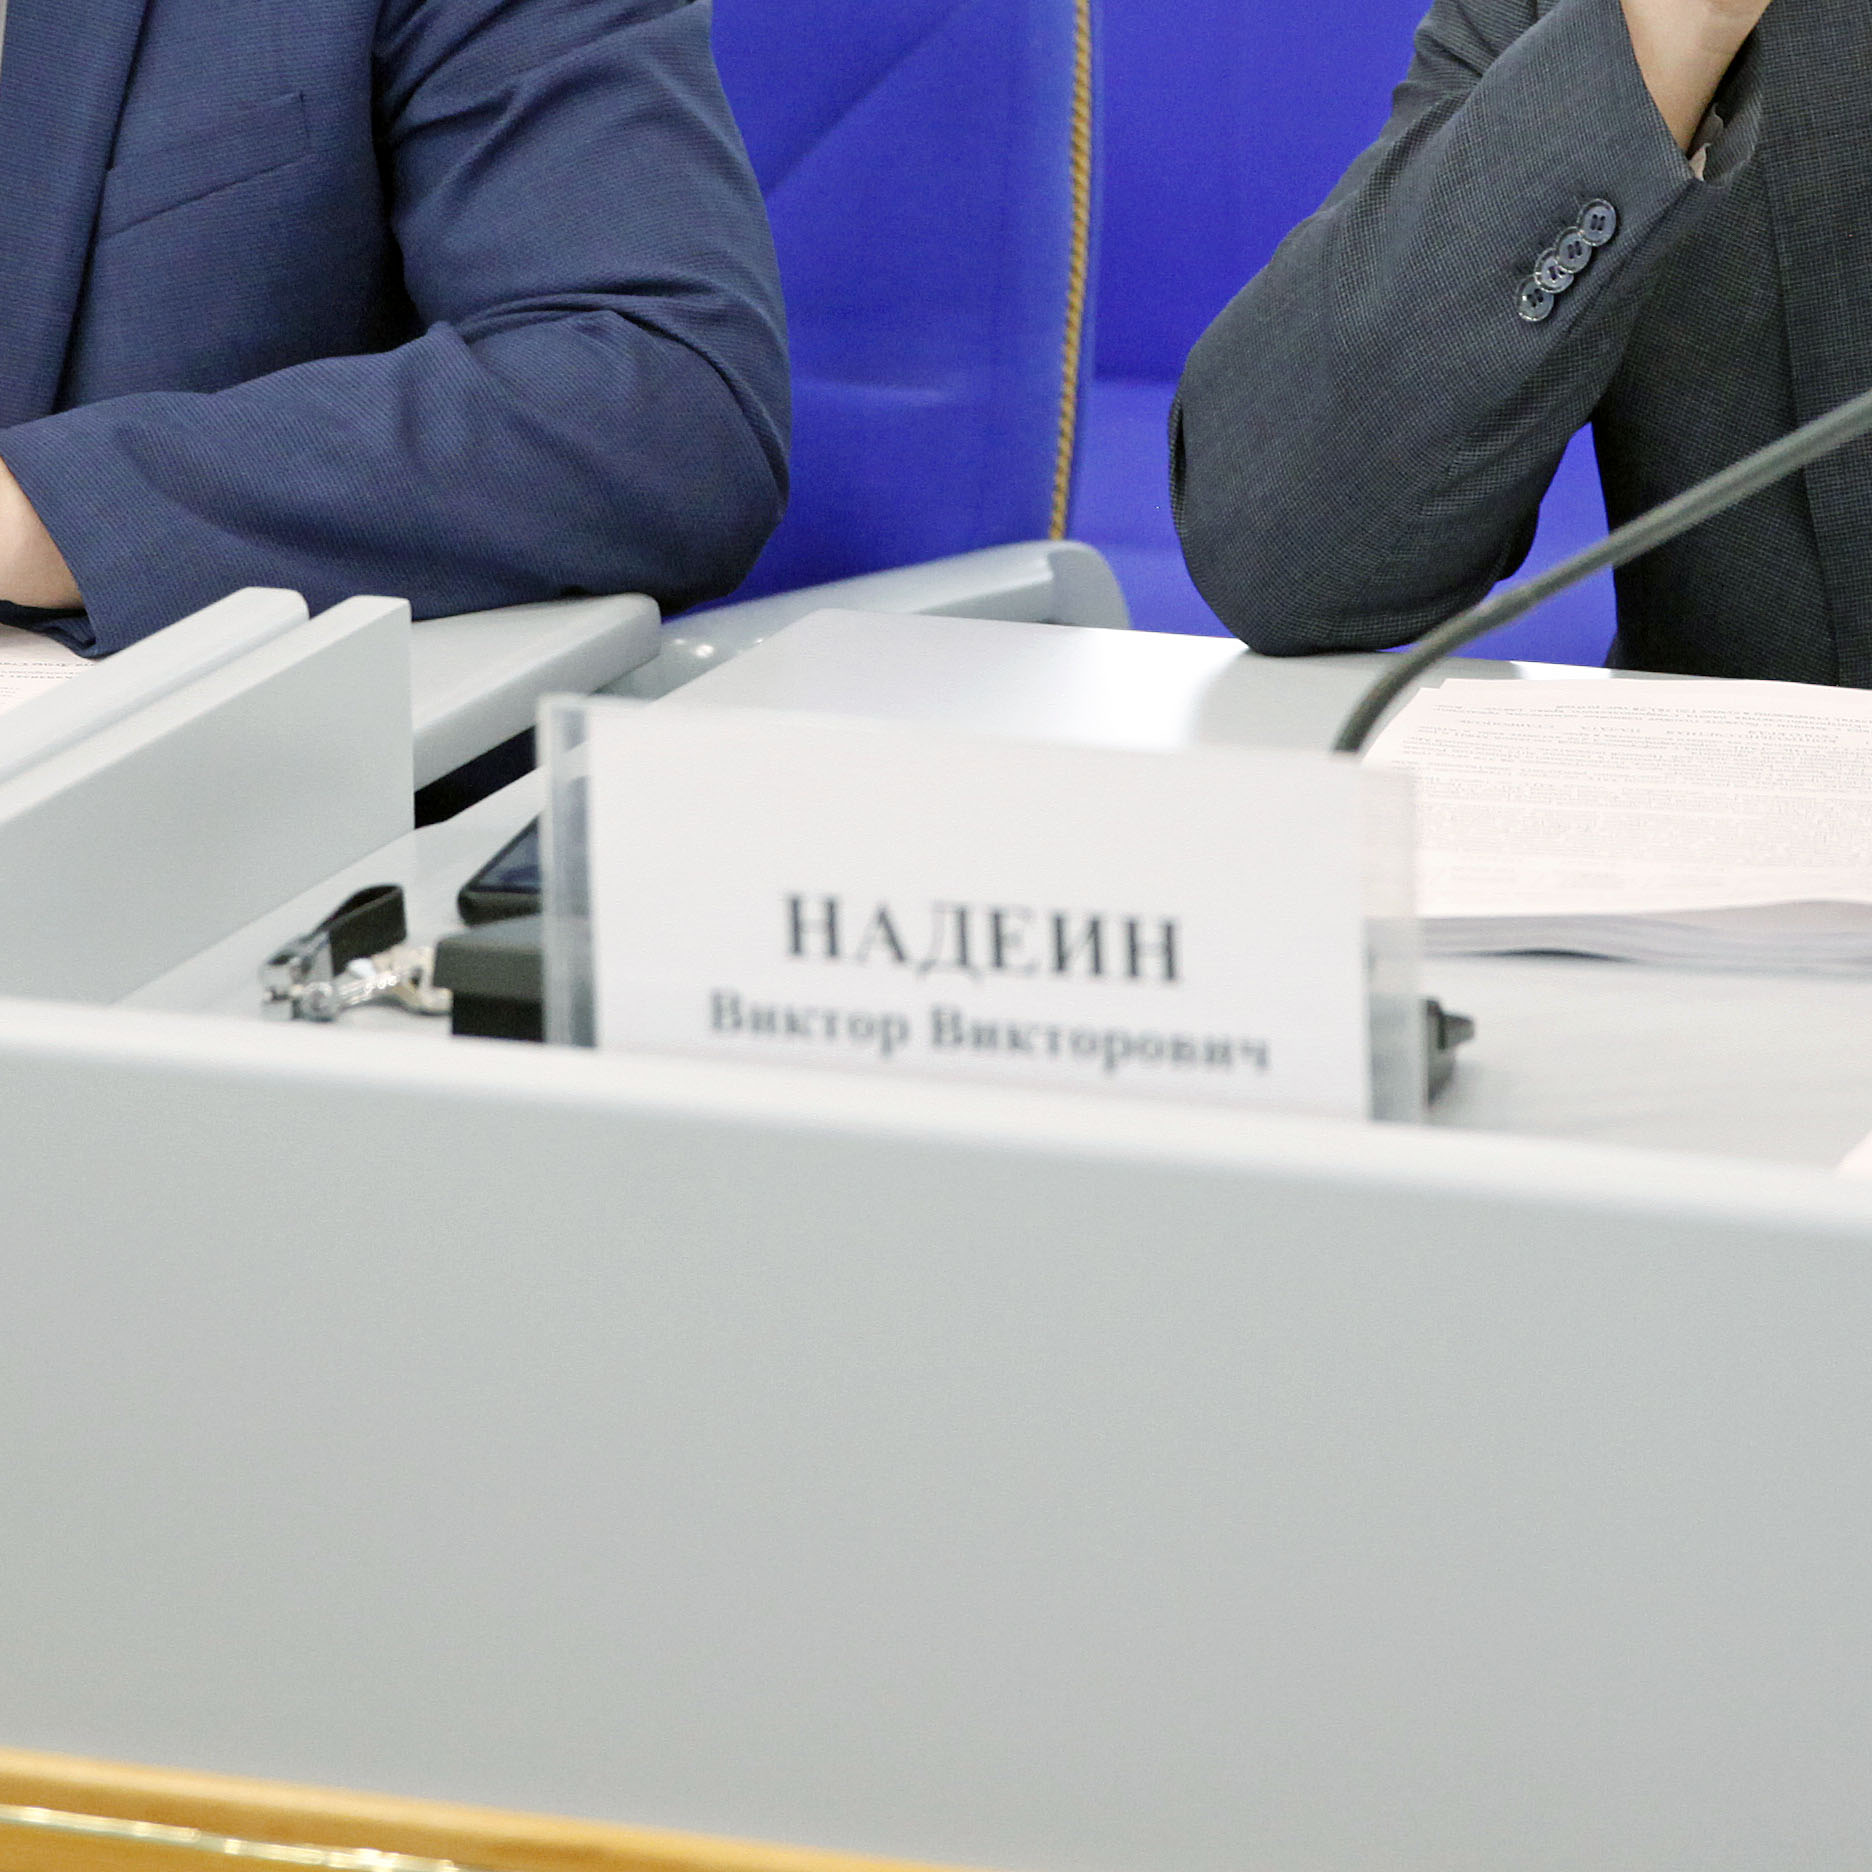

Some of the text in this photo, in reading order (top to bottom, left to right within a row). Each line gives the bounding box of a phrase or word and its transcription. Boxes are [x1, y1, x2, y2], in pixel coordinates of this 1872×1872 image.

[785, 893, 1184, 983] НАДЕИН
[709, 989, 1270, 1078] Виктор Викторович
